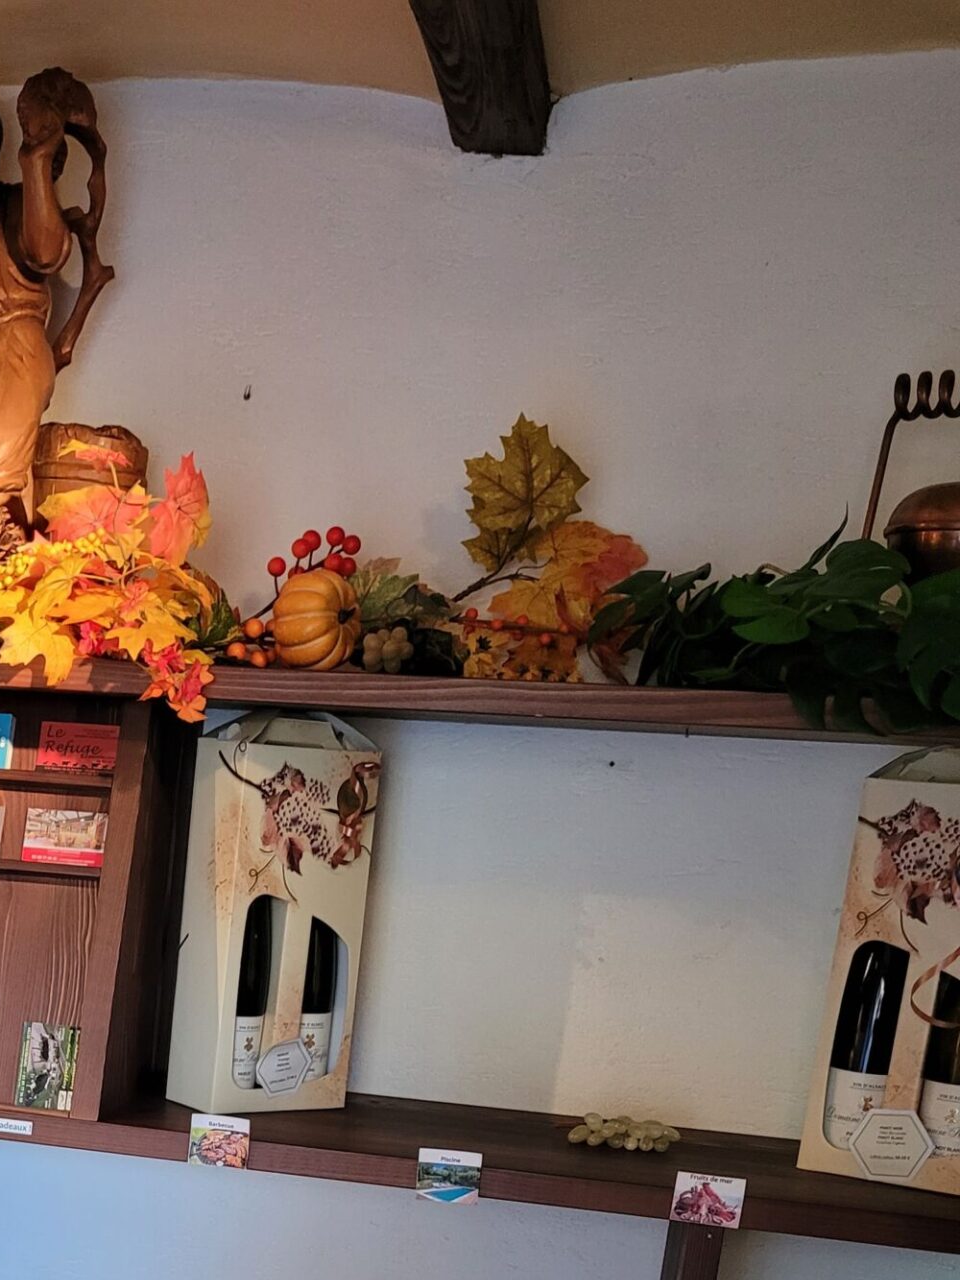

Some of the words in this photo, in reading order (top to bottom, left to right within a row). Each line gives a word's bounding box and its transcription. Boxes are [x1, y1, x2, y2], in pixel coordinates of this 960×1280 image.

[46, 724, 66, 738] Le
[44, 739, 102, 756] Refuge
[208, 1120, 235, 1130] Barbecue
[440, 1155, 461, 1164] Piscine
[689, 1173, 710, 1183] Fruits
